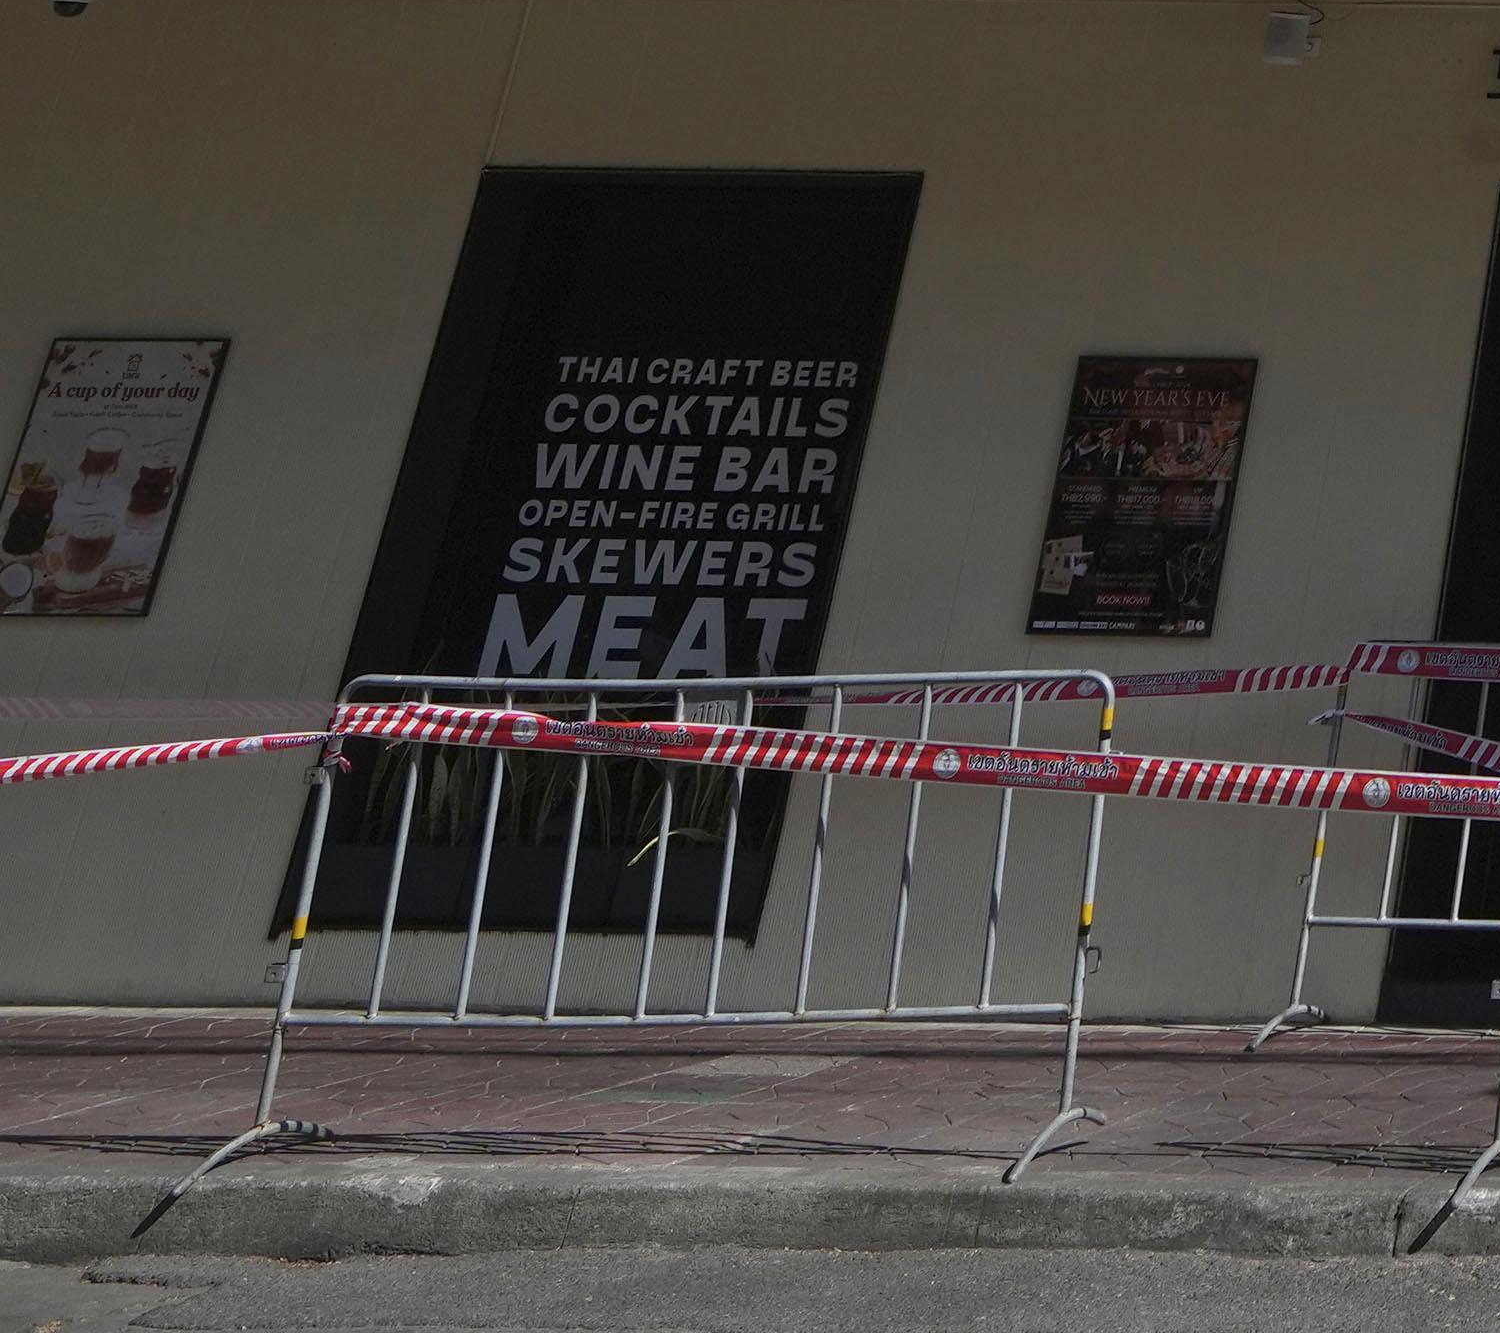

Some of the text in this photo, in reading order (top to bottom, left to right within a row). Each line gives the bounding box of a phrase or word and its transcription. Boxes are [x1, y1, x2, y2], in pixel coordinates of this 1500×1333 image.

[48, 381, 201, 402] A cup of your day
[558, 356, 859, 388] THAI CRAFT BEER
[544, 393, 851, 438] COCKTAILS
[1083, 387, 1231, 407] NEW YEAR'S EVE
[535, 443, 838, 494] WINE BAR
[518, 498, 825, 532] OPEN-FIRE GRILL
[502, 537, 818, 588] SKEWERS
[476, 592, 809, 679] MEAT
